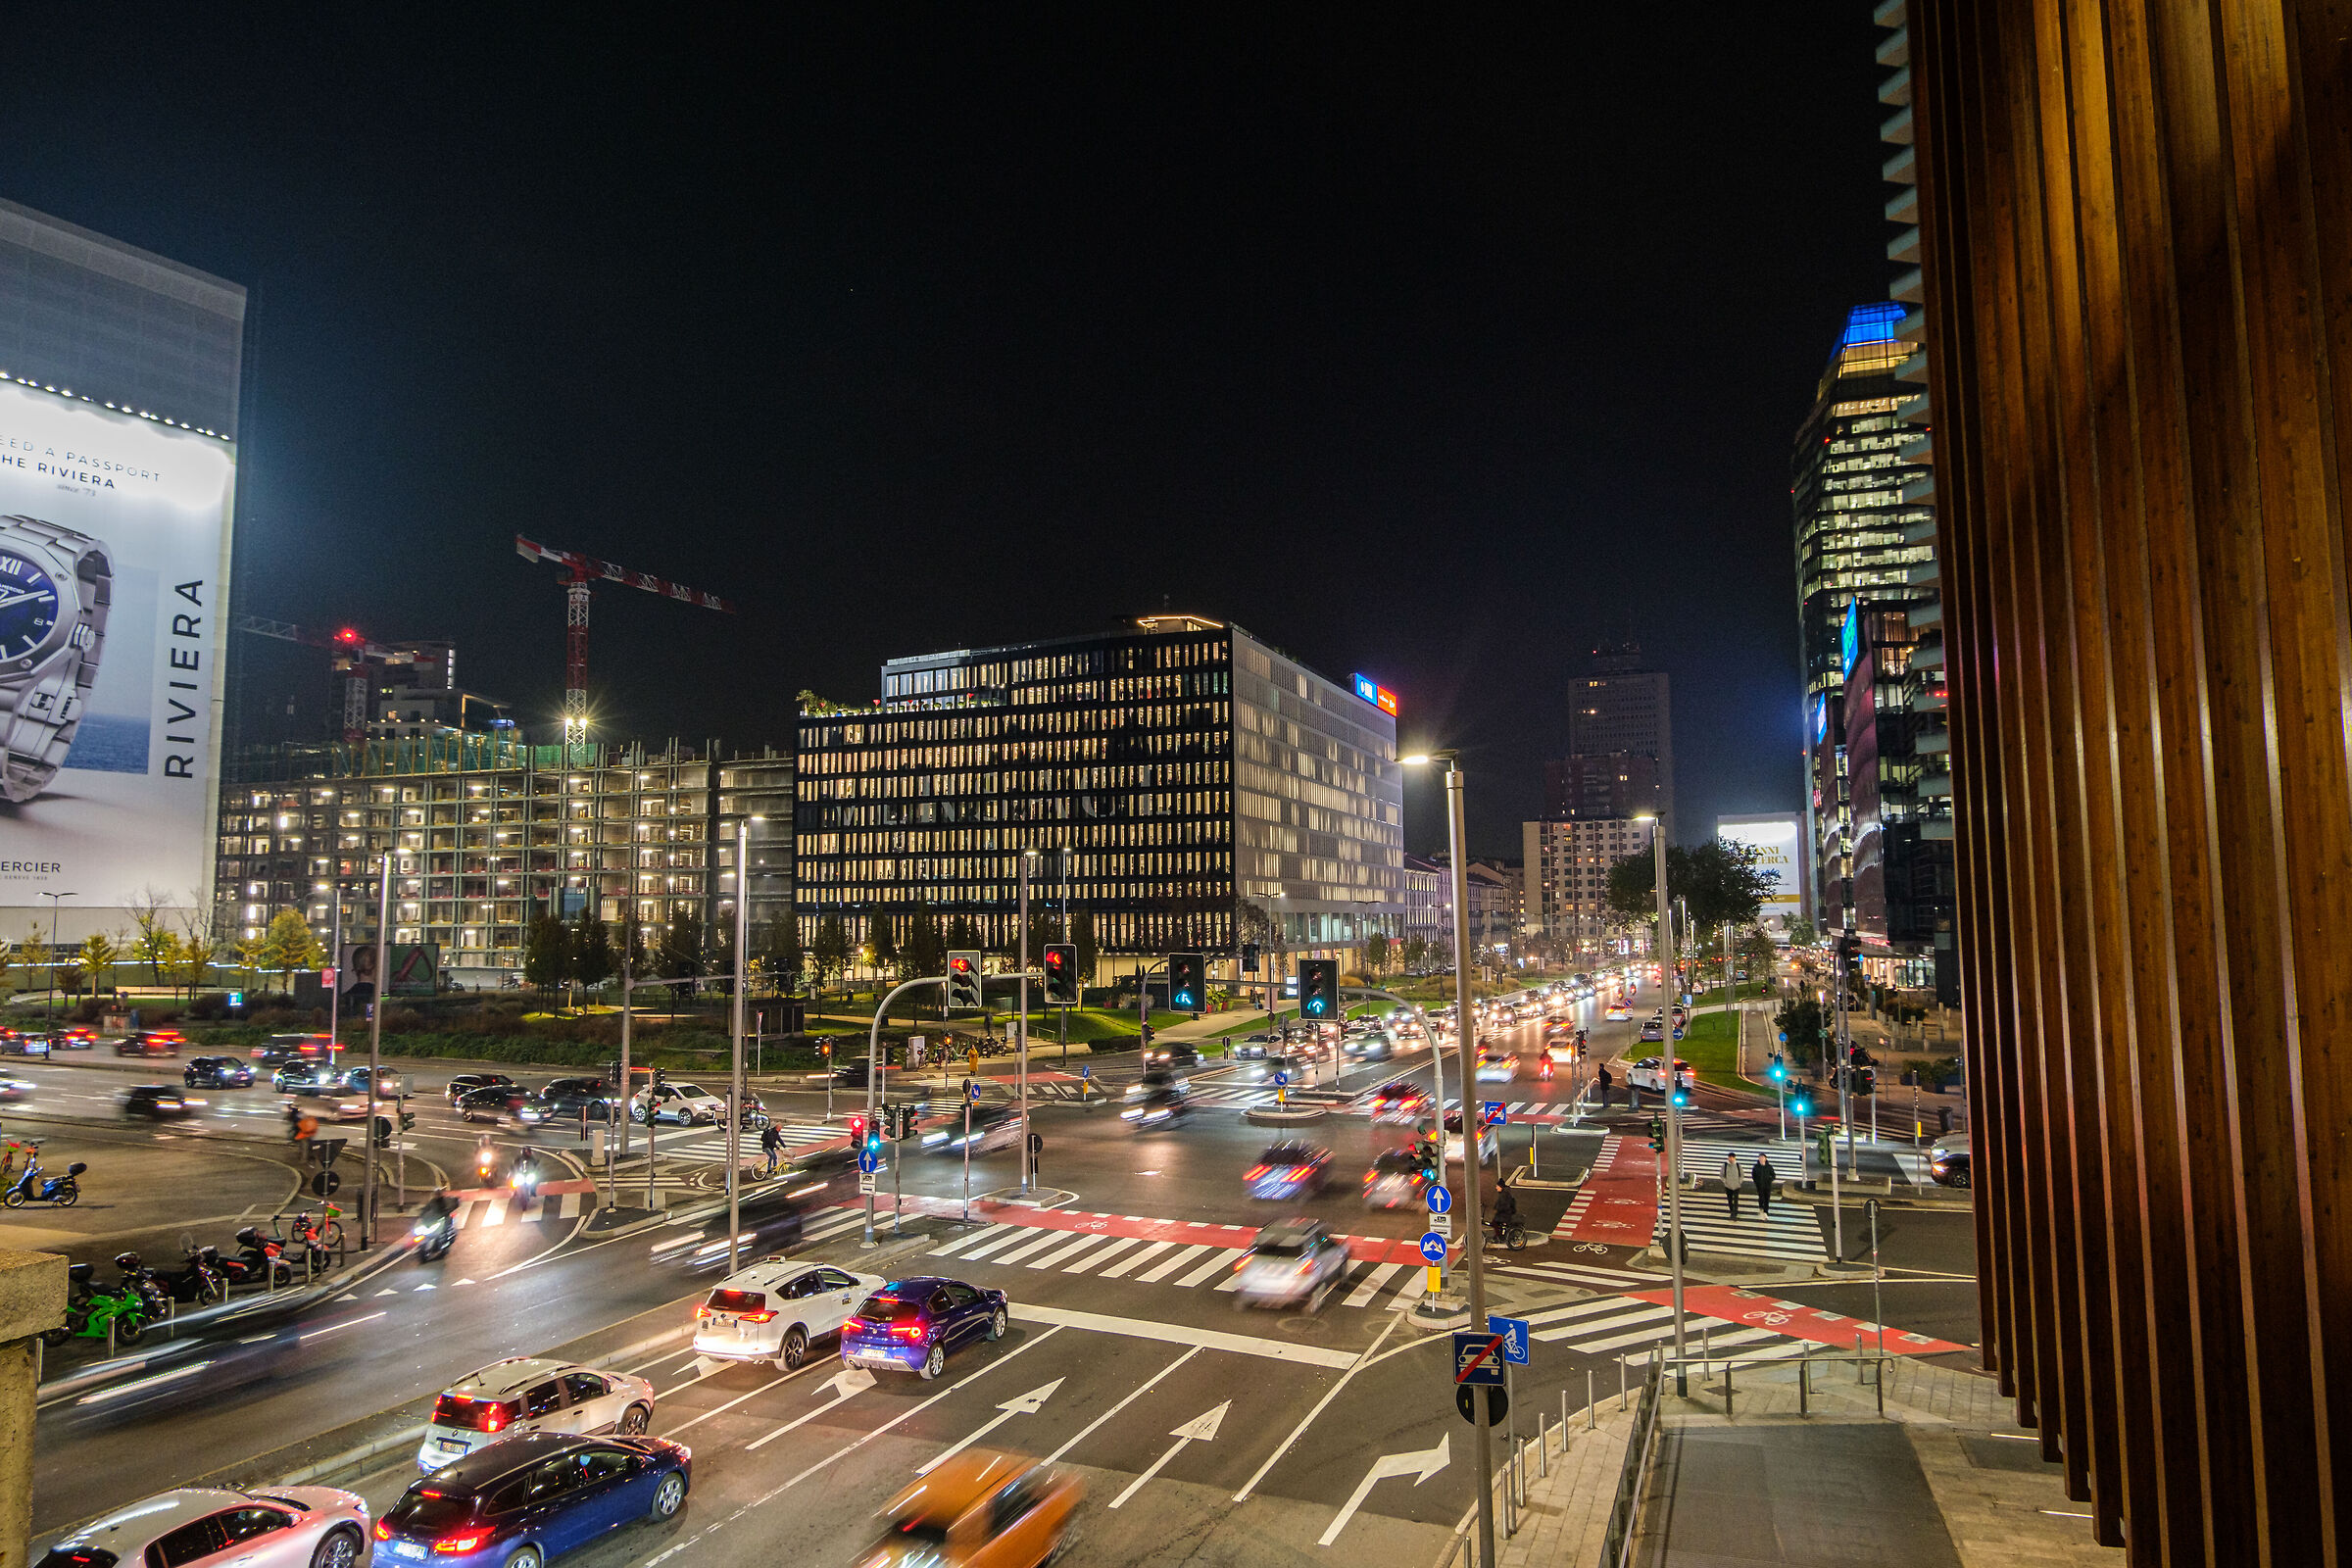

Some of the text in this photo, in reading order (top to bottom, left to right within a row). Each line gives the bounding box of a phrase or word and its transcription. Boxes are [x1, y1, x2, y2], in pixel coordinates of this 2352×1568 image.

[37, 462, 116, 490] RIVIERA
[45, 447, 55, 458] A
[67, 451, 161, 482] PASSPORT
[164, 579, 203, 779] RIVIERA
[1, 860, 61, 873] ERCIER
